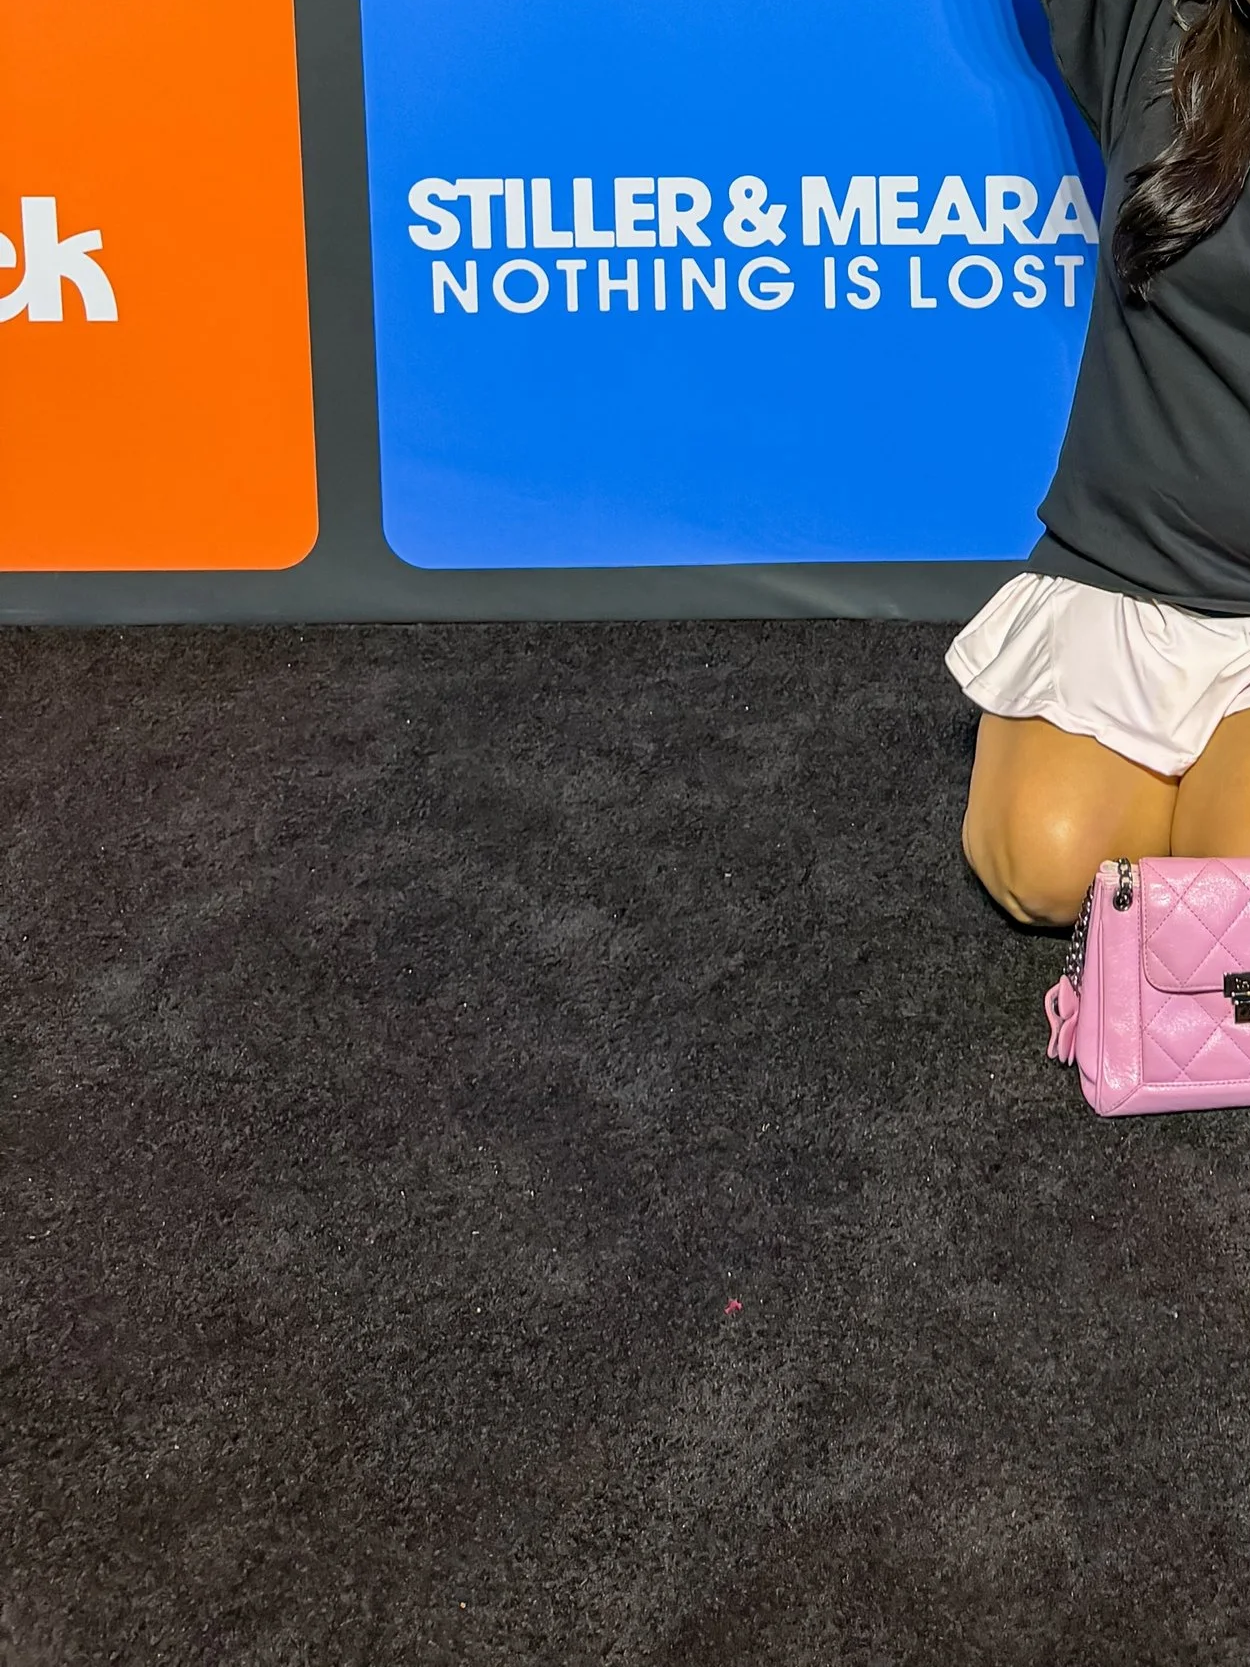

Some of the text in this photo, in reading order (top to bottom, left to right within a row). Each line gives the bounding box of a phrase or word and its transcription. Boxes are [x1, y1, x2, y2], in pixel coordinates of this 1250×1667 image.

[408, 175, 1100, 251] STILLER & MEARA
[432, 254, 1084, 314] NOTHING IS LOST
